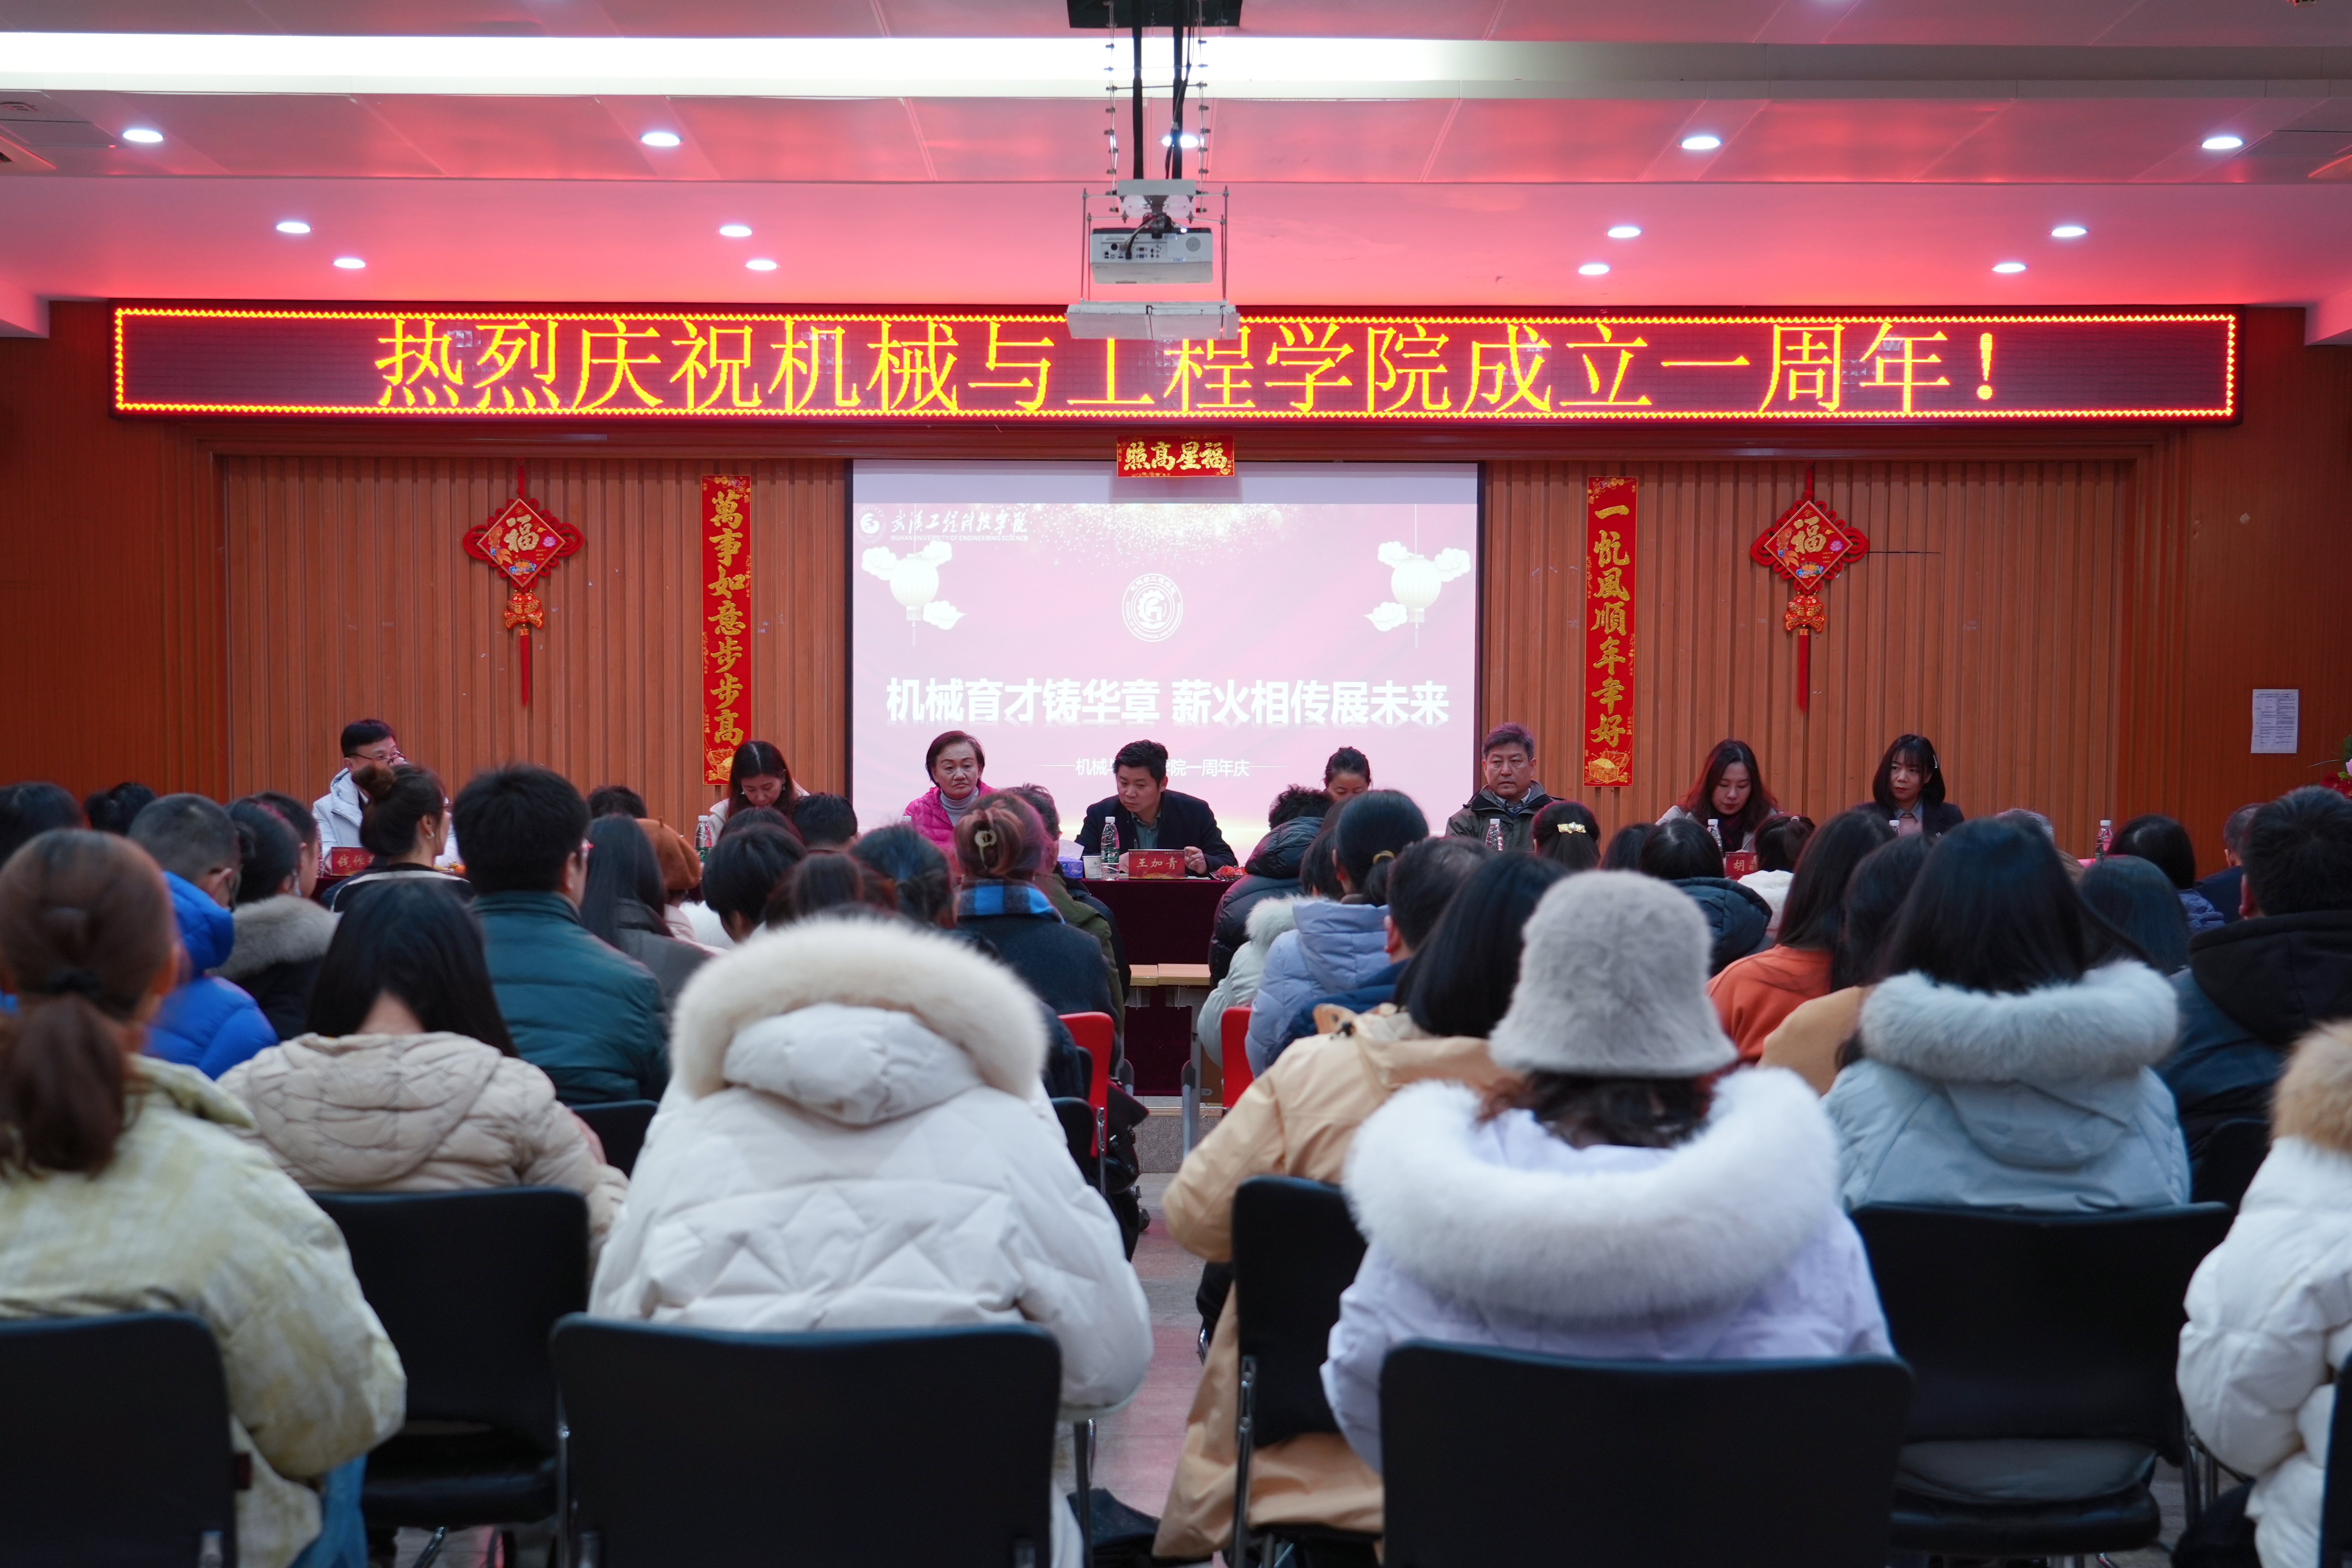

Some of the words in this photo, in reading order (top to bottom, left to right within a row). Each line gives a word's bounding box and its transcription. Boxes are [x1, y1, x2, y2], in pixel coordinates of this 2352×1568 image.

[375, 318, 1993, 412] 热烈庆祝机械与工程学院成立一周年！
[504, 514, 539, 552] 福
[1791, 516, 1826, 554] 福
[1133, 626, 1160, 638] MECHANICAL
[887, 677, 1160, 723] 机械育才铸华章
[1172, 679, 1449, 724] 薪火相传展未来
[1136, 856, 1177, 869] 王加青
